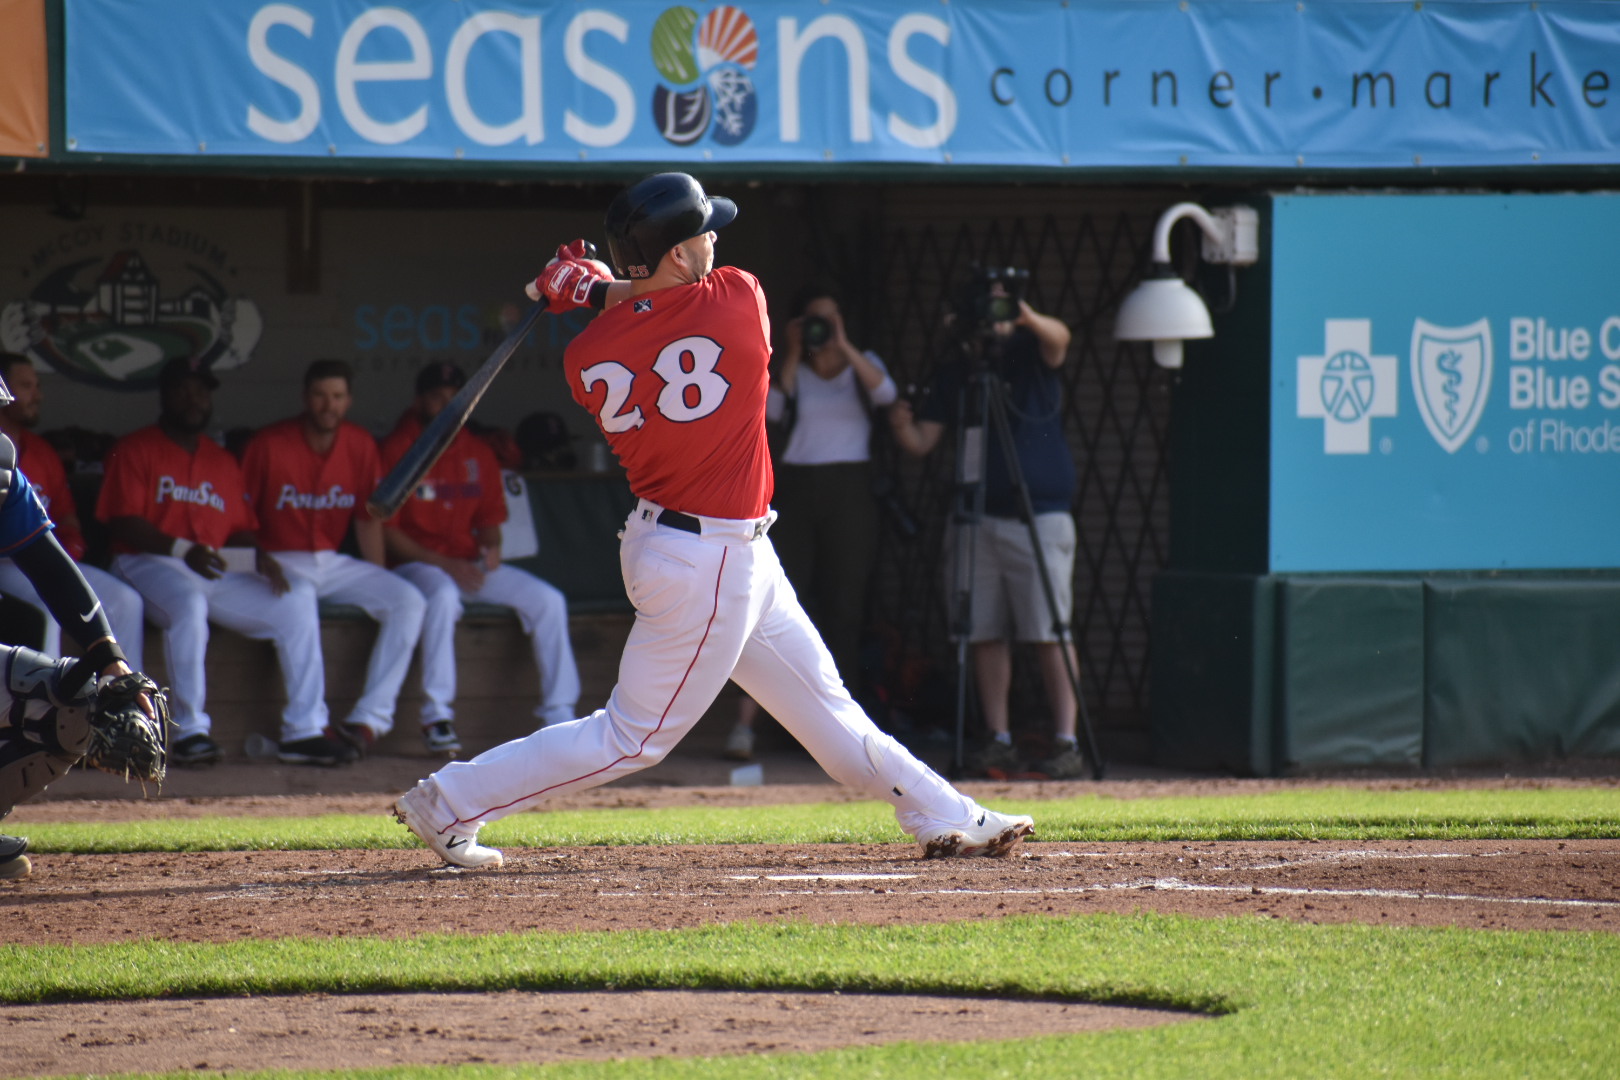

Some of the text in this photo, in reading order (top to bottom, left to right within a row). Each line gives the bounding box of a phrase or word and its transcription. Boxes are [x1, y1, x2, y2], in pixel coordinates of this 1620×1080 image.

[988, 51, 1610, 108] corner marke
[119, 221, 228, 266] STADIUM
[1509, 317, 1591, 361] Blue
[580, 335, 731, 434] 28
[1509, 366, 1591, 409] Blue
[1508, 418, 1535, 453] of
